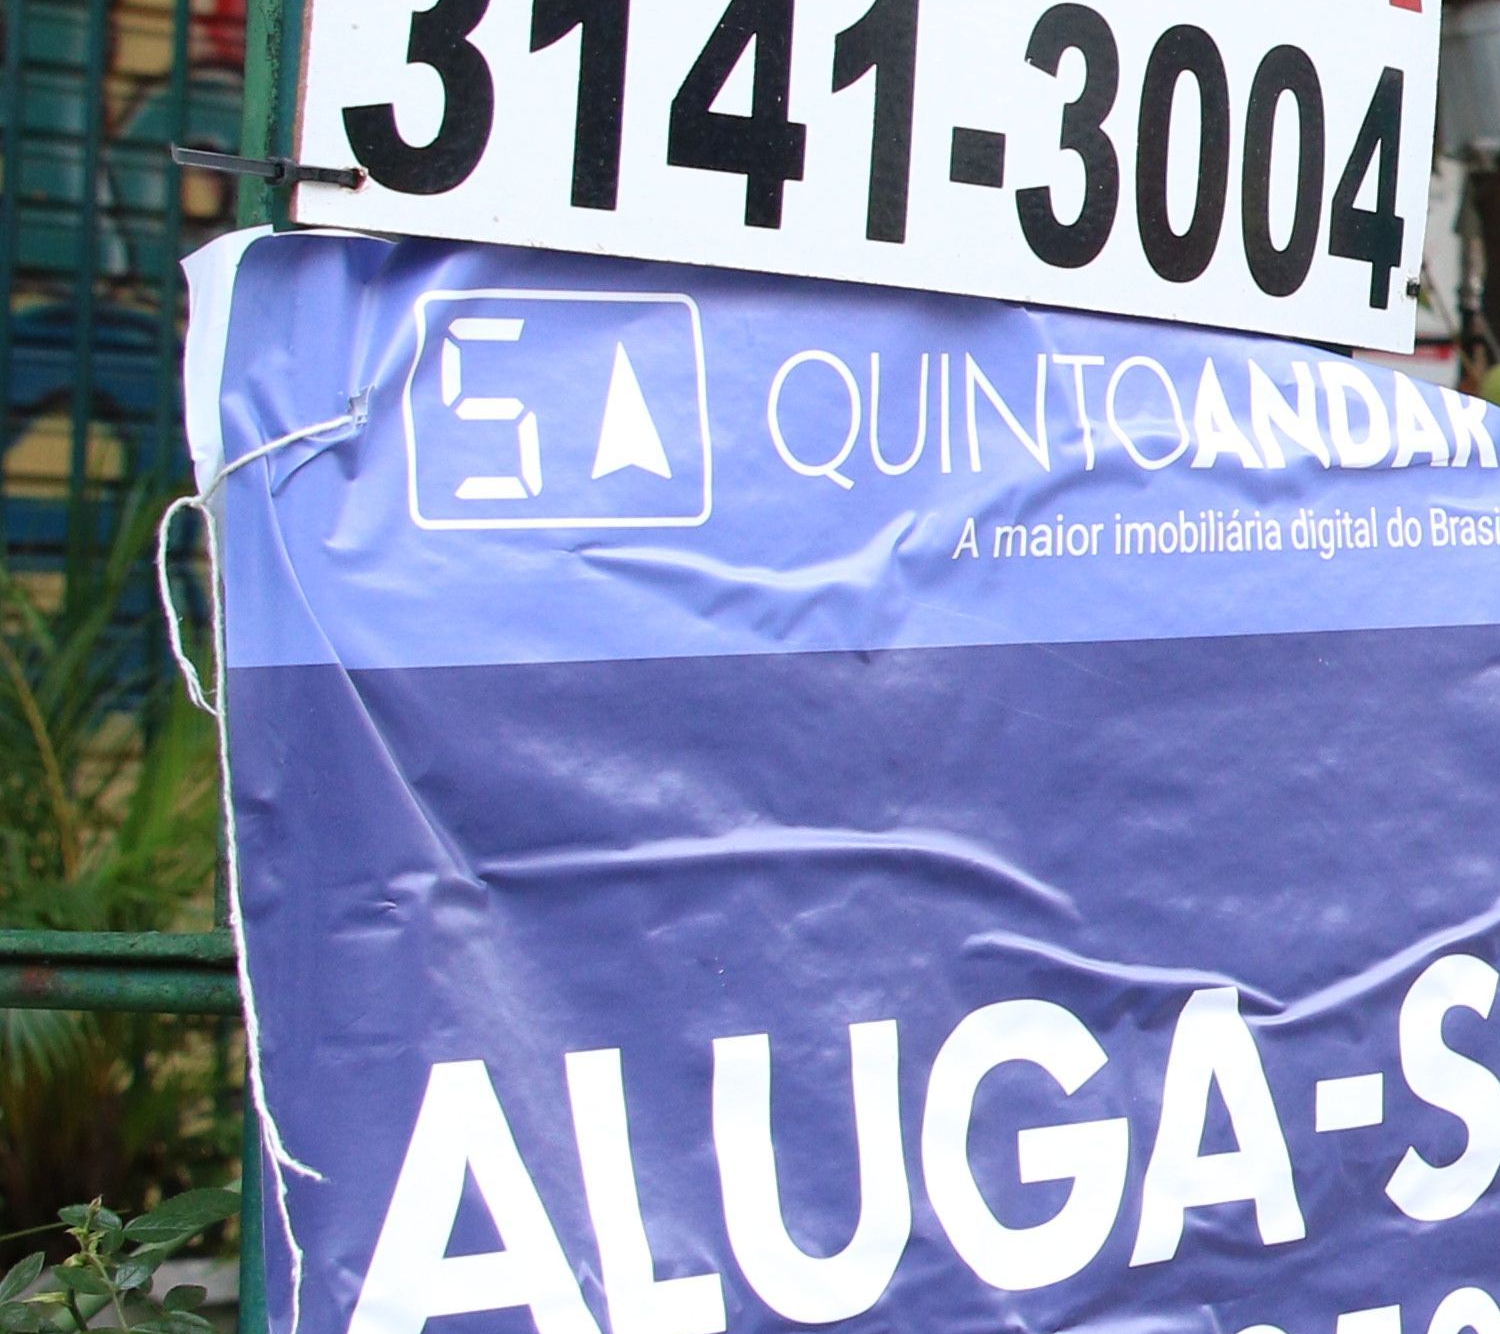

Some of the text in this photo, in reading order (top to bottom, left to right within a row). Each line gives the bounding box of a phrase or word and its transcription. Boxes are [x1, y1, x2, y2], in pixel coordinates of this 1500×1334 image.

[767, 349, 1499, 490] QUINTOANDAR
[953, 518, 979, 560] A
[994, 516, 1104, 558] maior
[1114, 509, 1282, 555] imobiliária
[1291, 507, 1378, 560] digital
[1386, 508, 1423, 548] do
